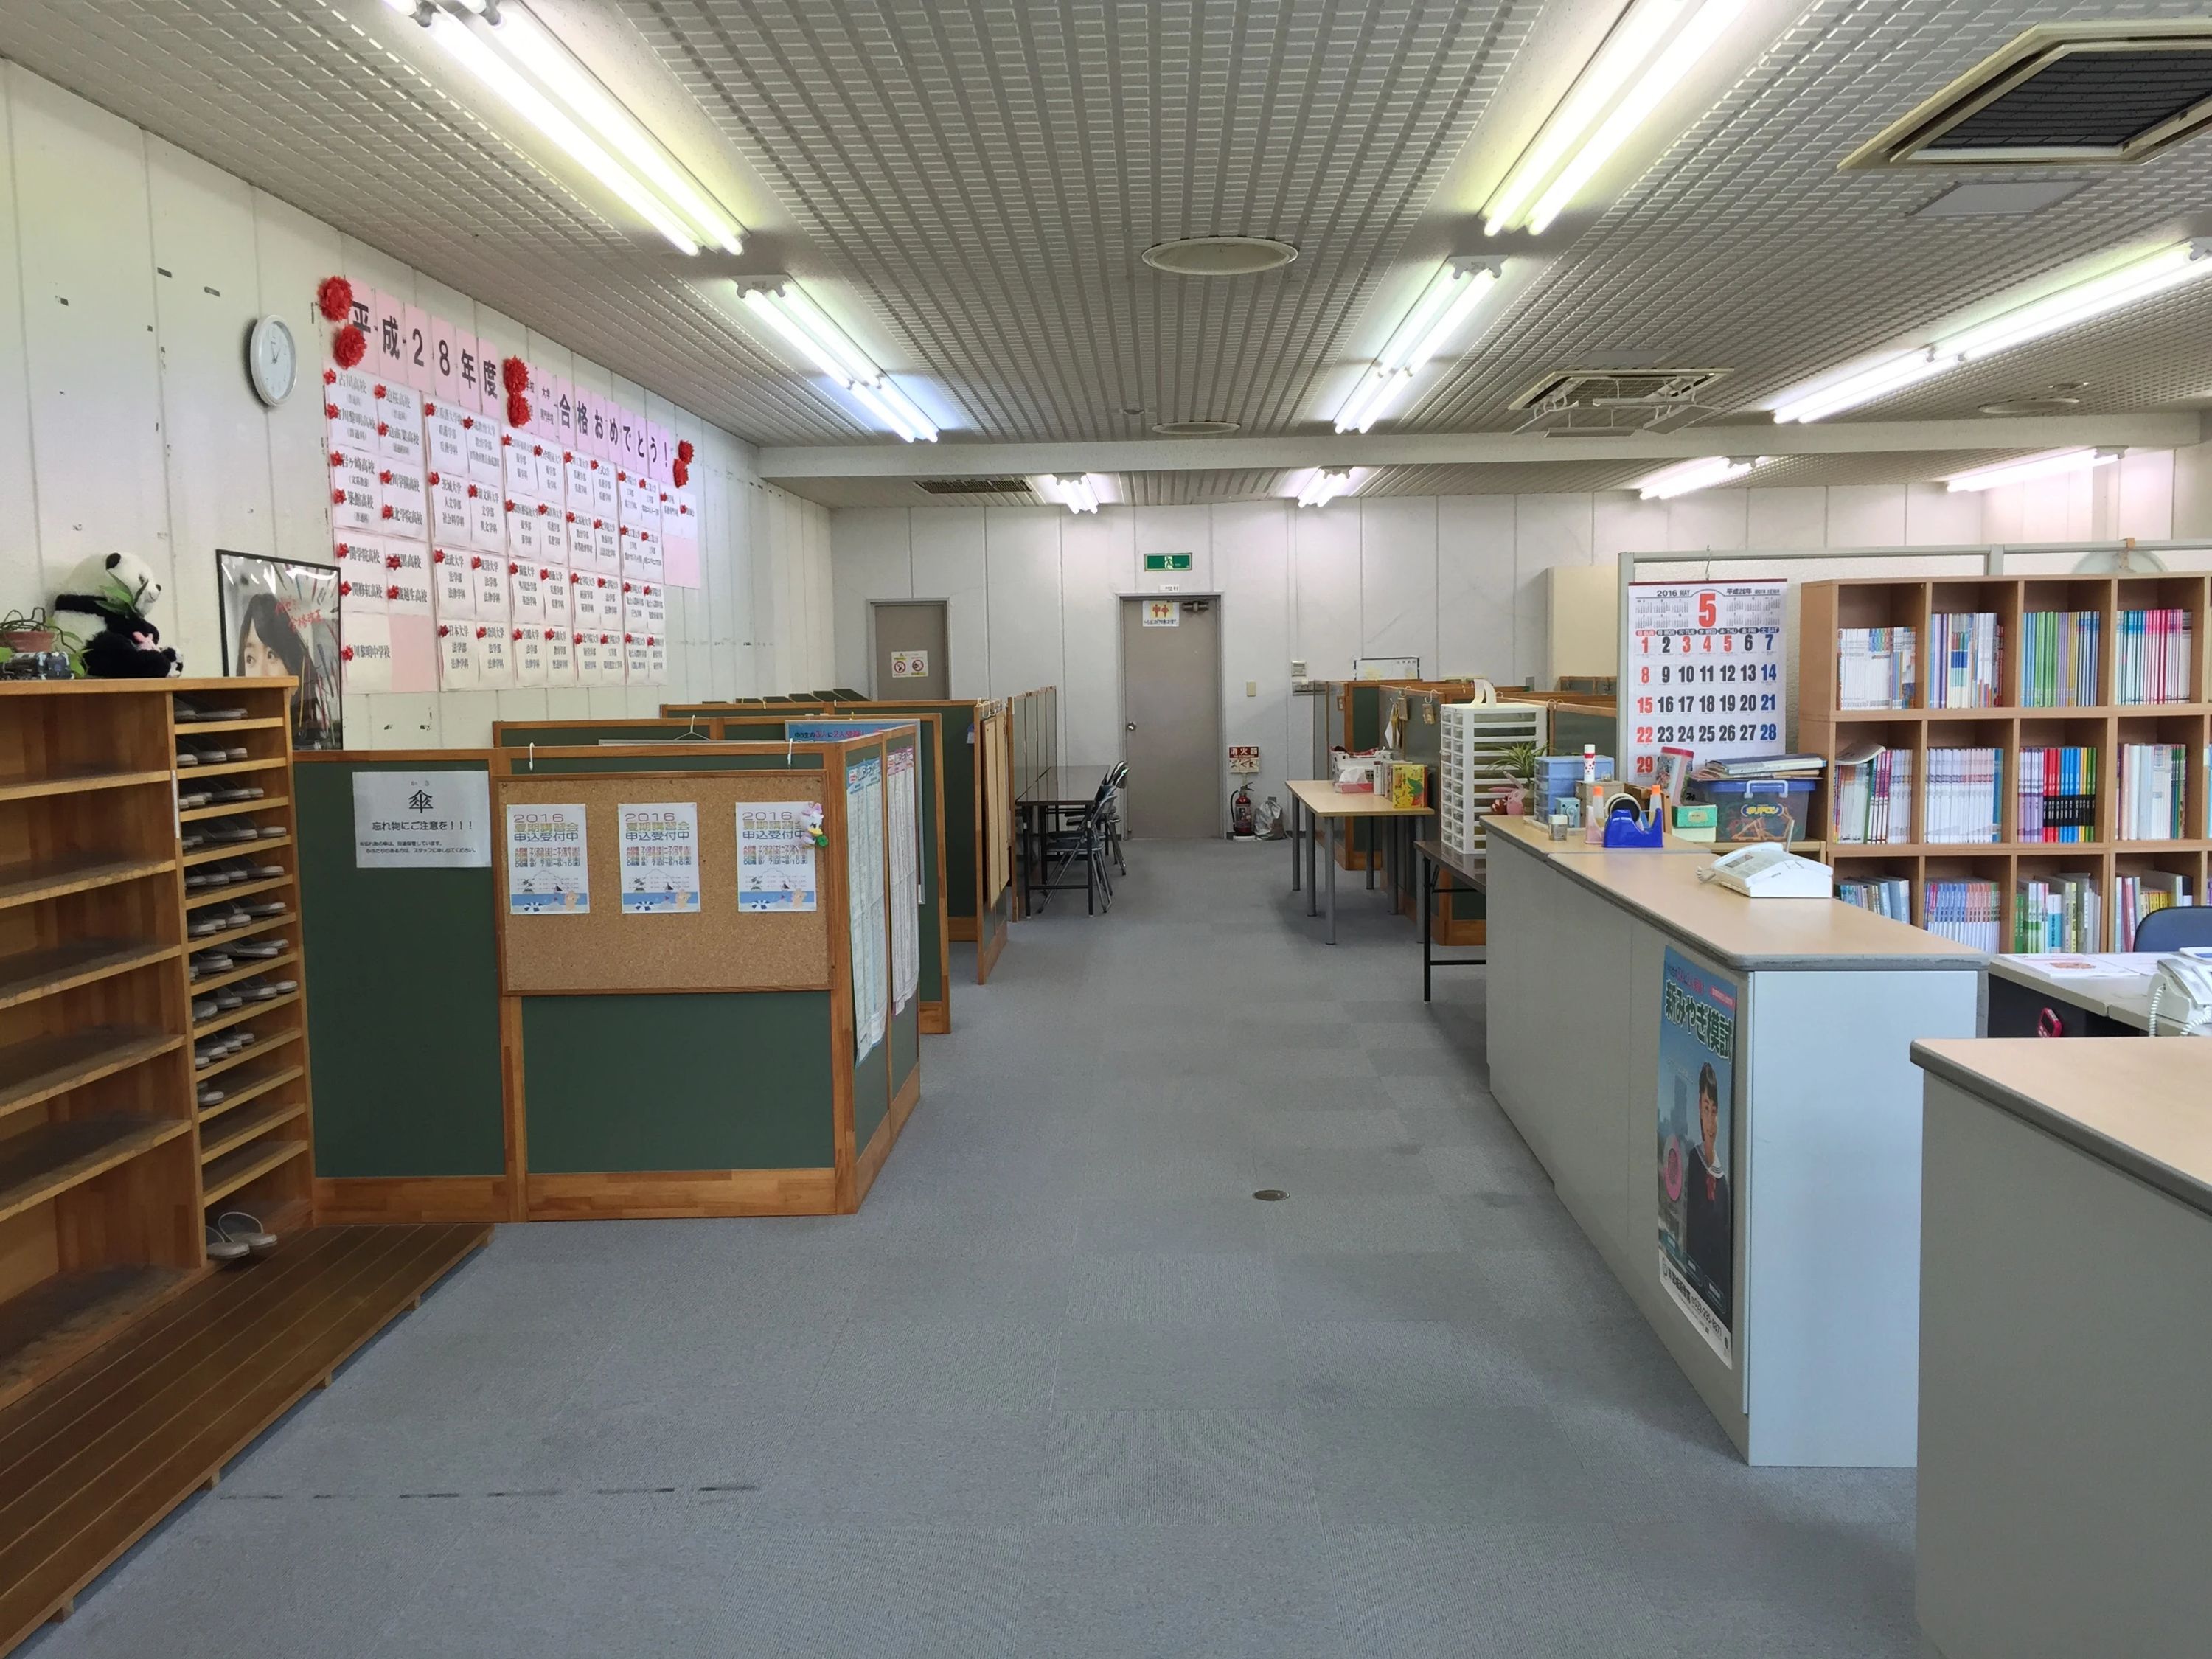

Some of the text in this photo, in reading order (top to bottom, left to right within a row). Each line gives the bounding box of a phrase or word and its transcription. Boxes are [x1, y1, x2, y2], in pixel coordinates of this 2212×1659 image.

[1699, 593, 1716, 627] 5
[354, 644, 391, 658] 川黎明中学校
[1641, 634, 1773, 653] 1 2 3 4 5 6 7
[1641, 664, 1776, 684] 8 9 10 11 12 13 14
[1638, 694, 1775, 714] 15 16 17 18 19 20 21
[1637, 724, 1776, 743] 22 23 24 25 26 27 28
[1636, 757, 1653, 773] 29
[408, 790, 434, 813] 傘
[514, 814, 563, 823] 2016
[625, 813, 675, 821] 2016
[742, 812, 792, 821] 2016
[515, 832, 578, 842] 申込受付中
[626, 832, 689, 841] 申込受付中
[743, 830, 805, 839] 申込受付中
[1666, 979, 1732, 1064] 新みやぎ模試
